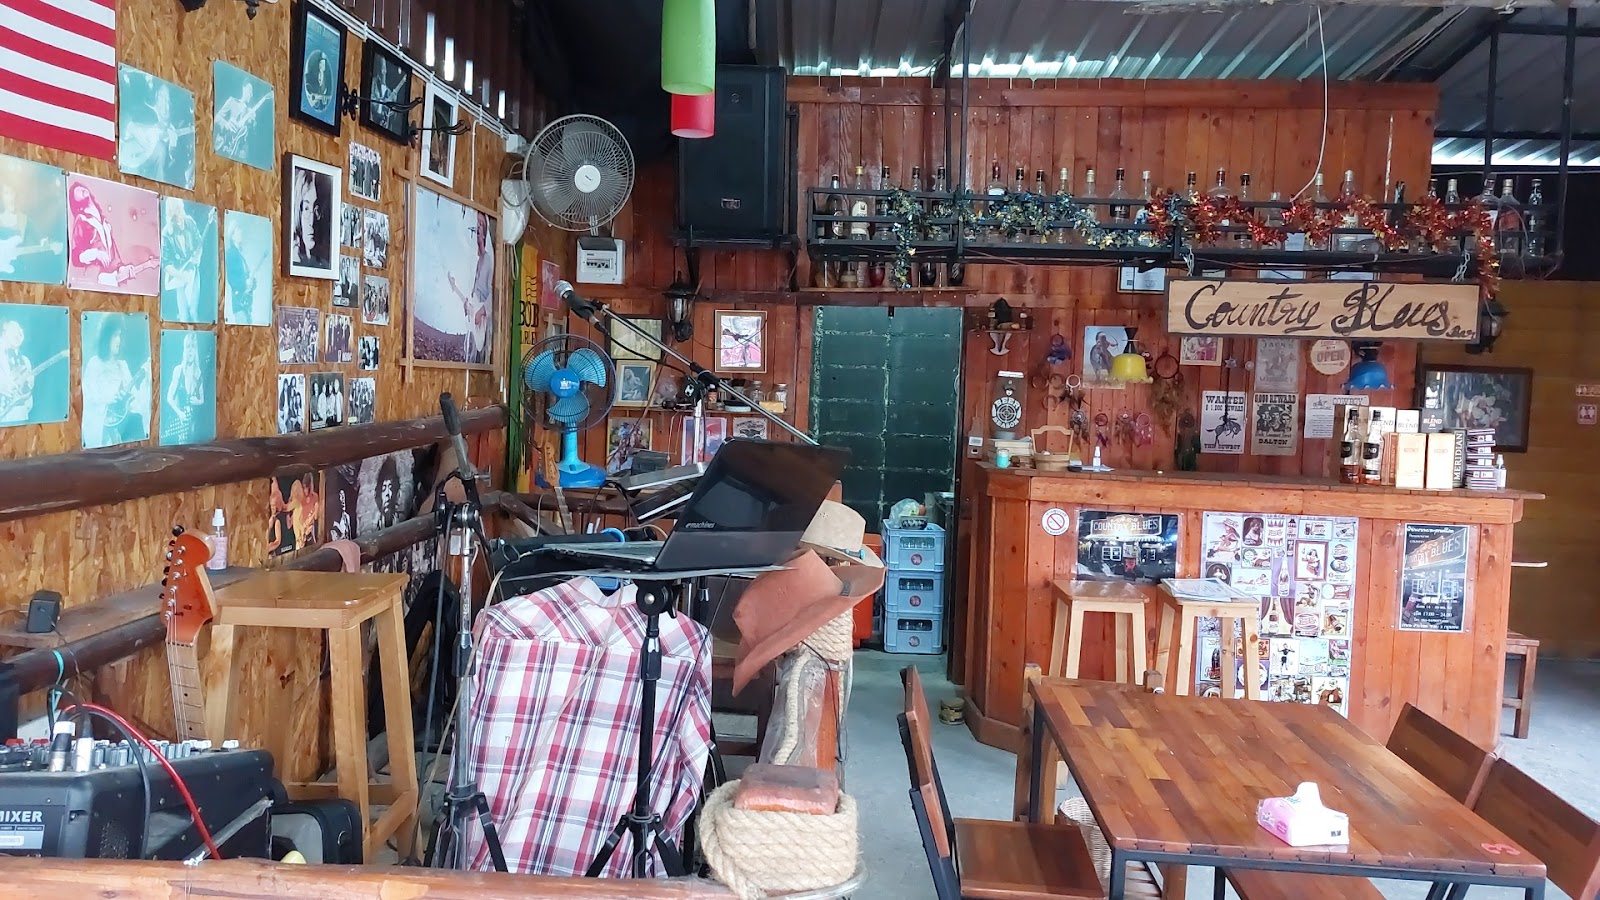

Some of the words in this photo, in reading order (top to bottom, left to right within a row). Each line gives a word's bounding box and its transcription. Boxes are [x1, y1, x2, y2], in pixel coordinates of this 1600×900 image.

[519, 301, 539, 327] BOB
[1184, 280, 1324, 334] Country
[1331, 282, 1450, 336] Blues
[1316, 351, 1345, 362] OPEN
[994, 397, 1020, 410] BEER
[1205, 395, 1244, 405] WANTED
[1269, 394, 1297, 404] REWARD
[992, 416, 1019, 429] SEASON
[1453, 433, 1464, 480] MERIDIAN
[1093, 521, 1129, 531] COUNTRY
[1131, 519, 1159, 531] BLUES
[1431, 534, 1461, 557] BLUES
